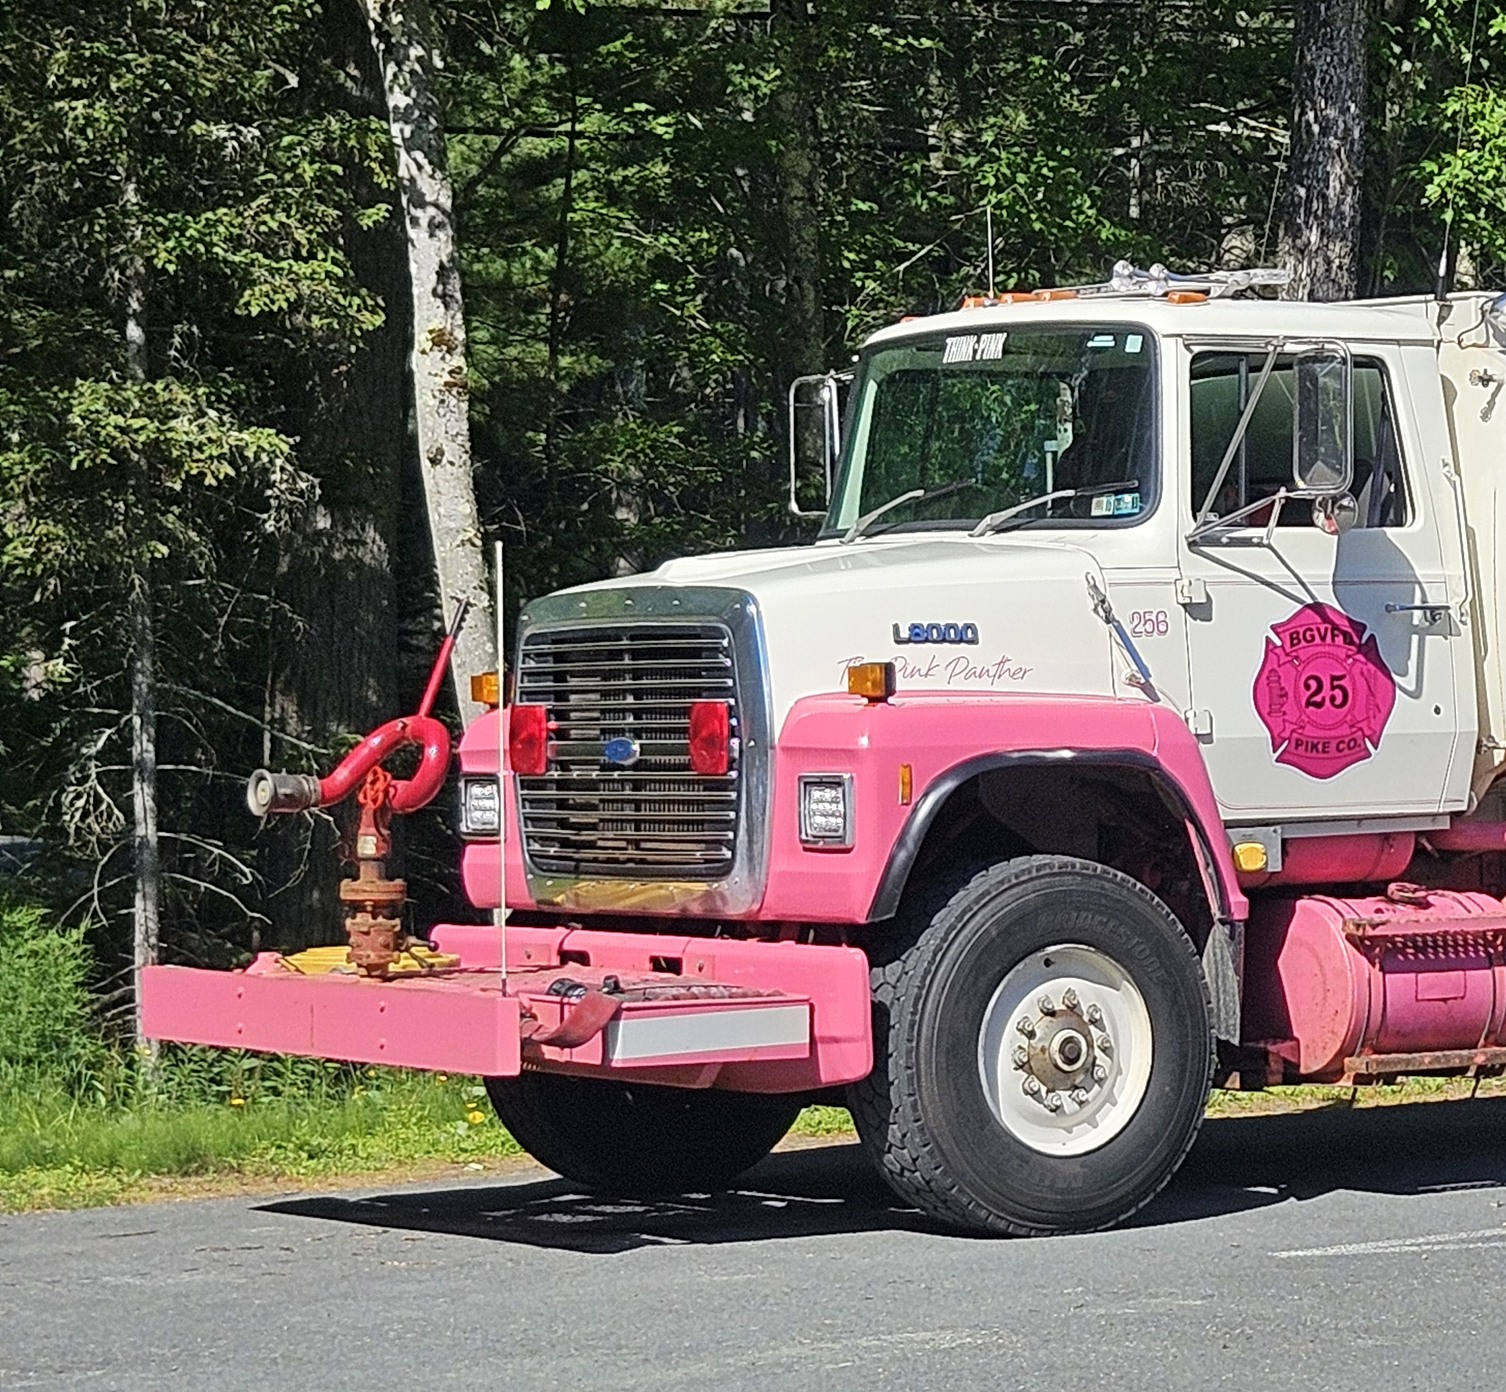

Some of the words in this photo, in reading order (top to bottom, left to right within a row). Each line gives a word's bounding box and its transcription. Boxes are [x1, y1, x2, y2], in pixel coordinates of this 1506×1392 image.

[893, 622, 980, 645] L8000
[1129, 610, 1169, 638] 256
[1288, 625, 1357, 649] BGVFD
[889, 654, 941, 679] Pink
[944, 654, 1035, 686] Panther
[1303, 673, 1350, 710] 25
[1294, 738, 1332, 755] PIKE
[1335, 736, 1362, 753] CO.
